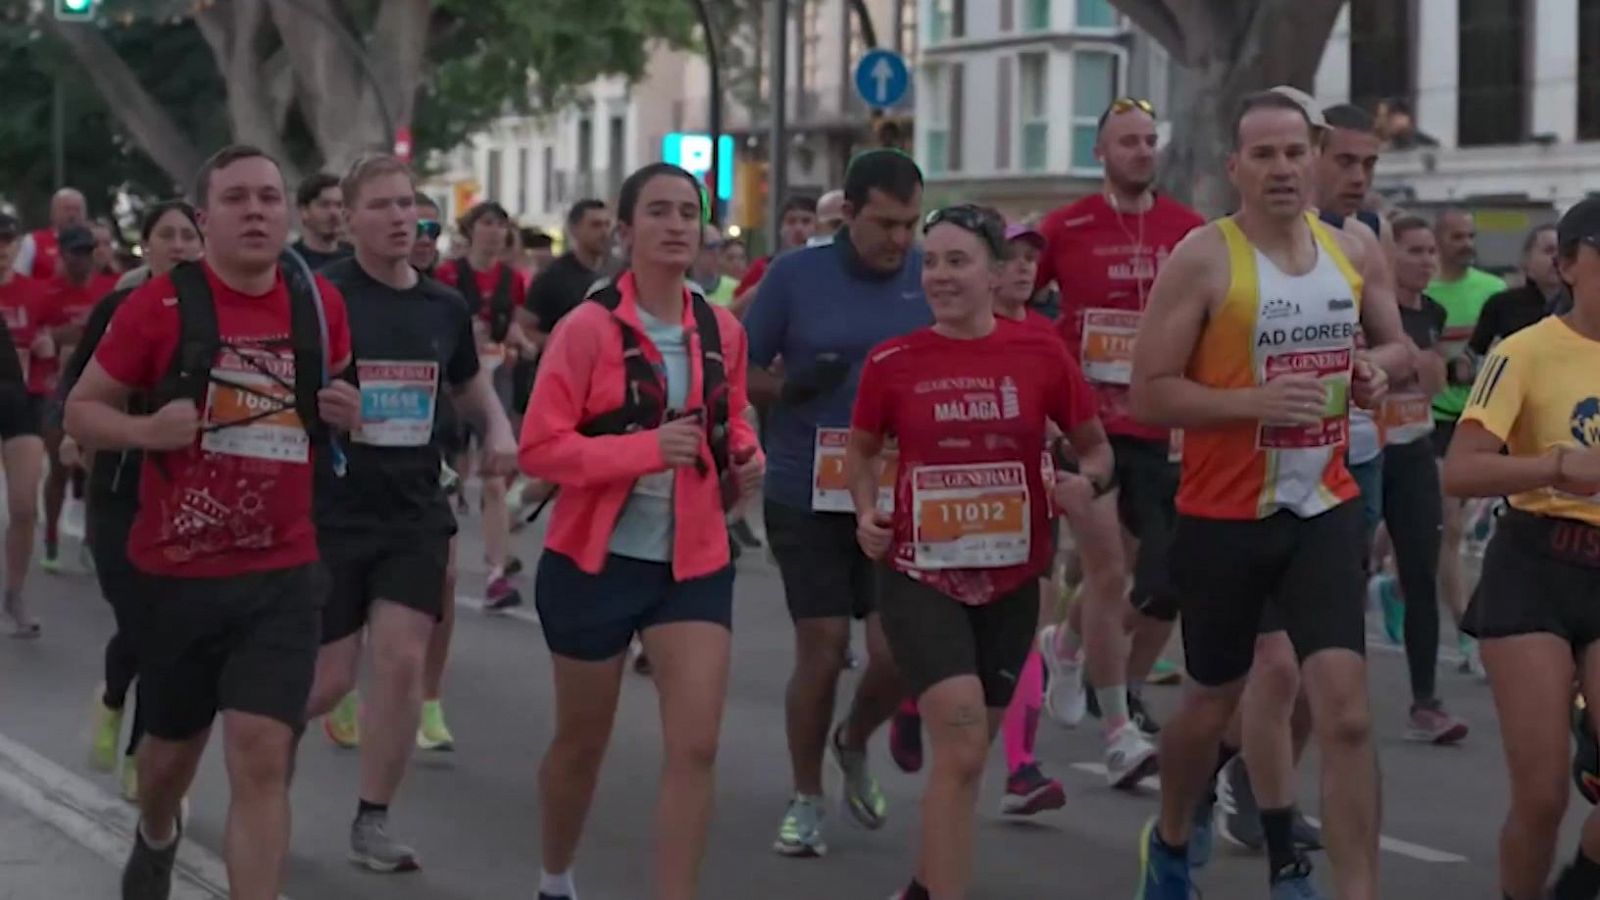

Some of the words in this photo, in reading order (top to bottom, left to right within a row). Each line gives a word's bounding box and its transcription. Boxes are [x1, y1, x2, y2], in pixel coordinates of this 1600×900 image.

[1258, 329, 1287, 347] AD
[1291, 322, 1357, 343] COREB
[934, 399, 1000, 422] MÁLAGA
[943, 467, 1022, 487] GENERALI
[940, 501, 1006, 523] 11012
